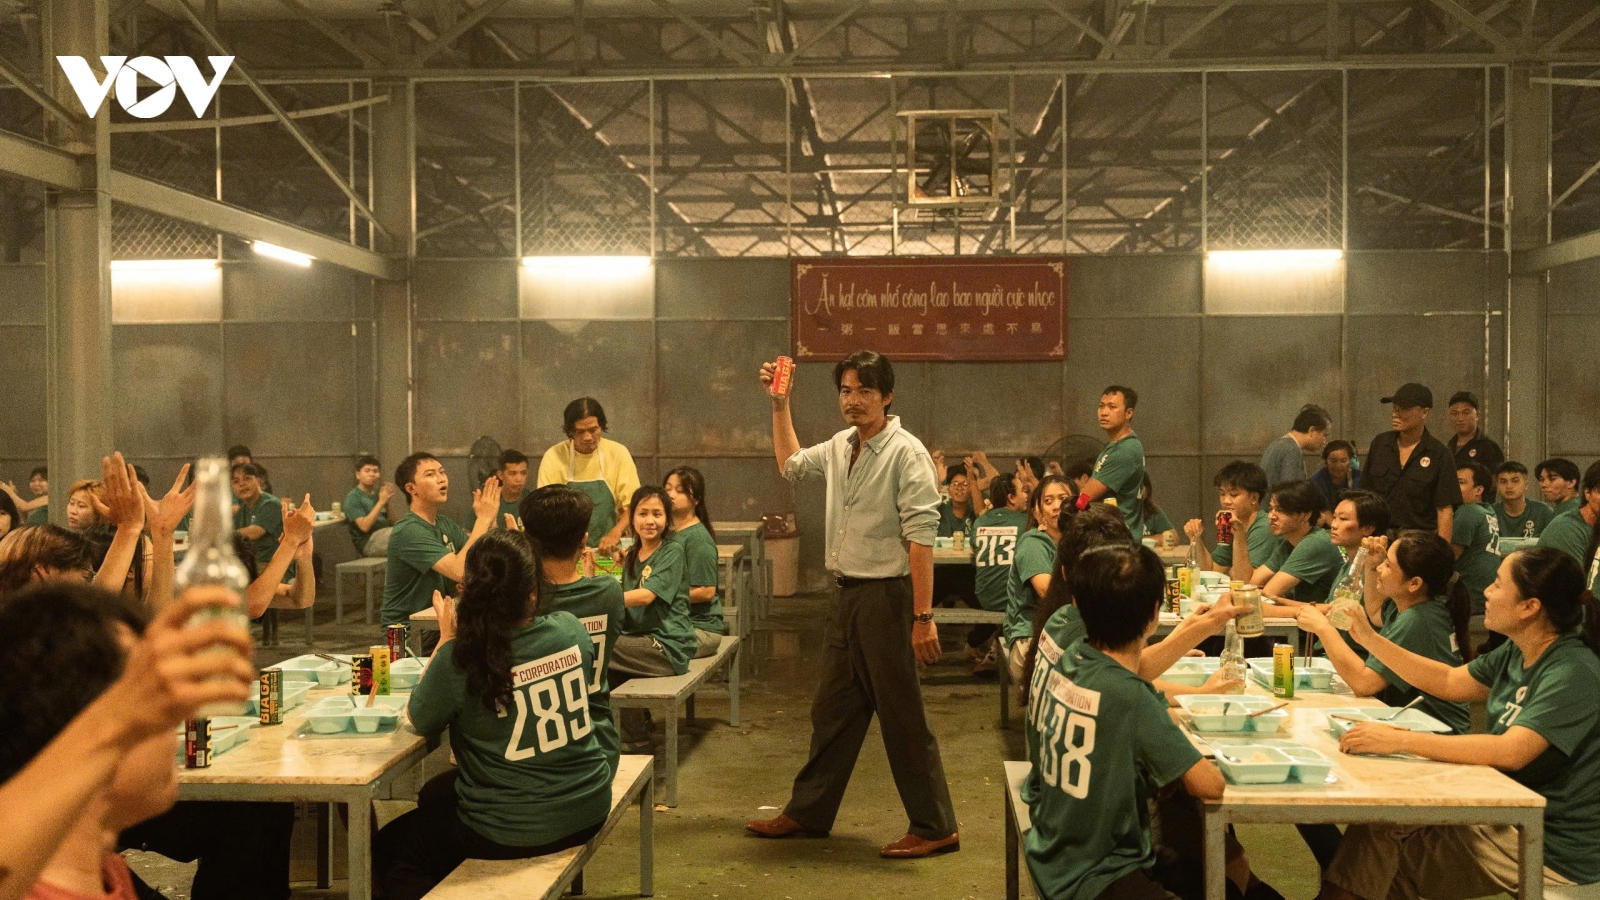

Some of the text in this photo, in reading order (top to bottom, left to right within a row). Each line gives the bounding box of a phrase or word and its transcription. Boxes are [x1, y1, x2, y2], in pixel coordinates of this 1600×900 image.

[930, 281, 950, 307] lao
[953, 281, 973, 307] bao
[975, 535, 1017, 567] 213
[519, 653, 578, 683] CORPORATION
[495, 667, 591, 762] 289
